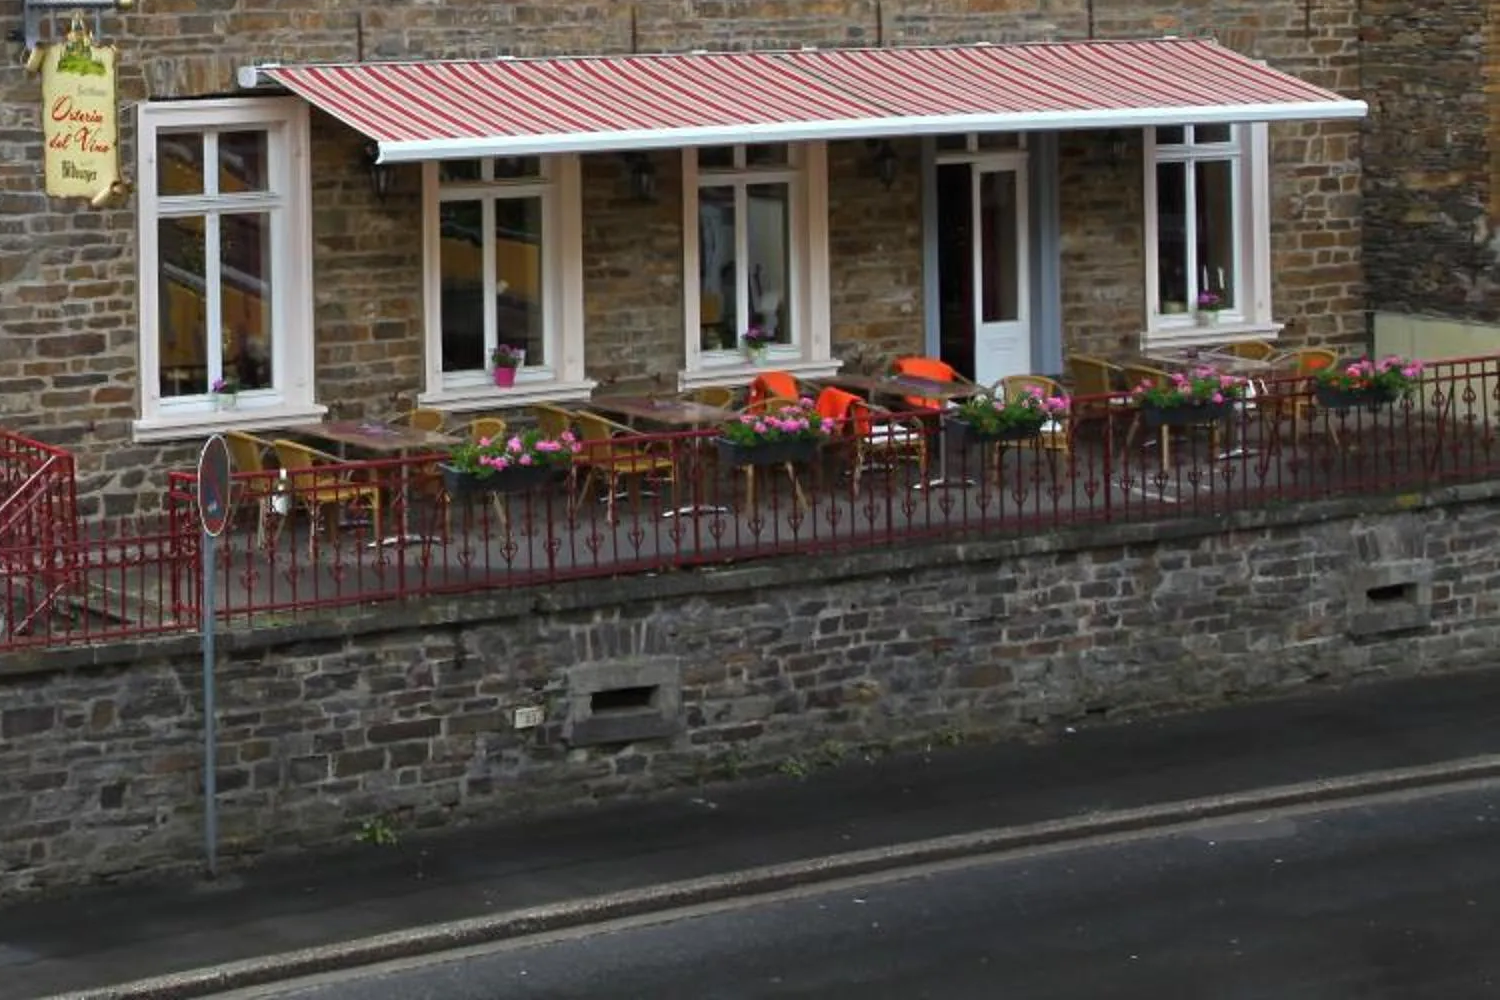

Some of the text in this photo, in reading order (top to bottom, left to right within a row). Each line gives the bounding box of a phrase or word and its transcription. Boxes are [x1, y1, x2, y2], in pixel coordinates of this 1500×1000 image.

[52, 96, 104, 122] Osteria
[49, 126, 111, 153] del Vino
